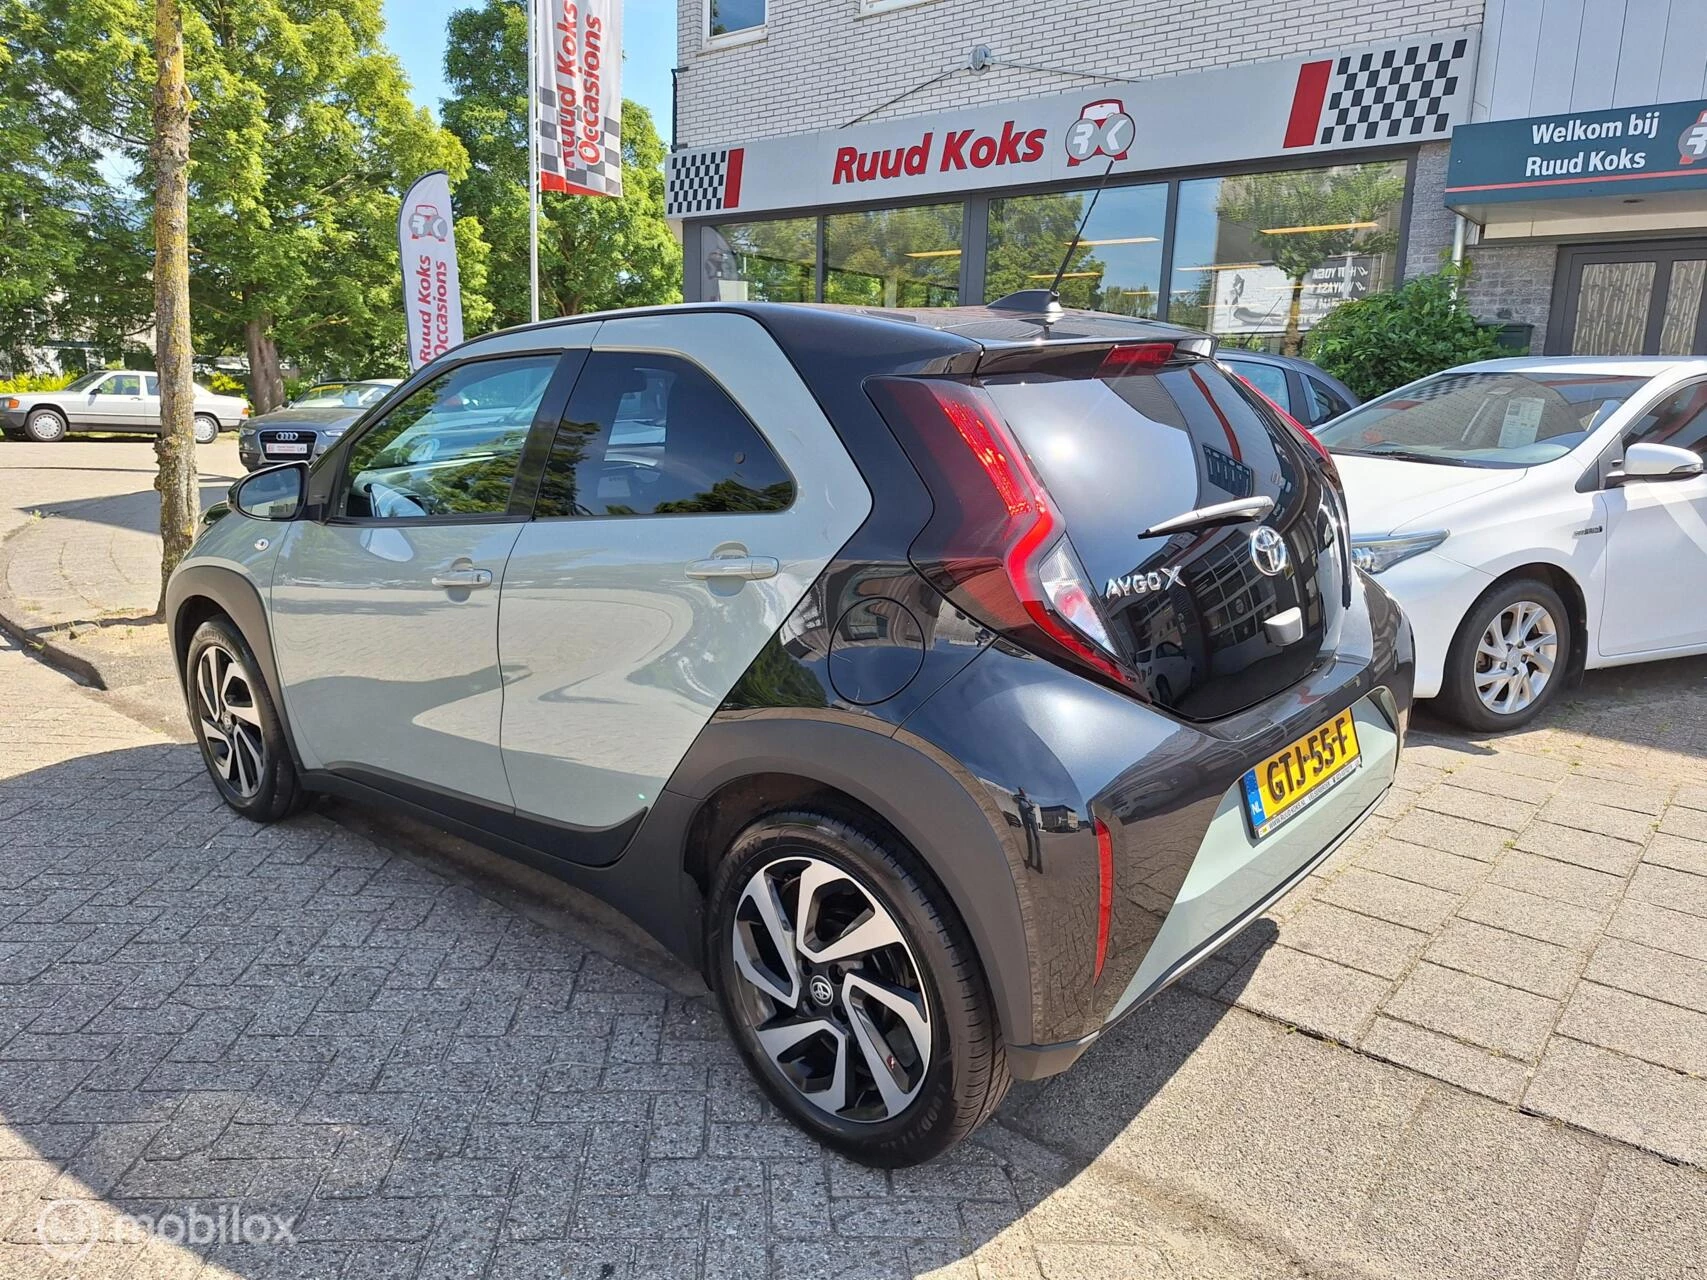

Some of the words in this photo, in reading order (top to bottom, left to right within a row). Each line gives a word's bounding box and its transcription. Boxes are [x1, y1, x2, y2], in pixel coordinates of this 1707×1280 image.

[556, 0, 578, 78] Koks
[577, 13, 602, 166] Occasions
[832, 132, 934, 185] Ruud
[939, 120, 1048, 172] Koks
[1531, 119, 1623, 145] Welkom
[1627, 111, 1660, 139] bij
[1525, 151, 1584, 177] Ruud
[1588, 147, 1646, 173] Koks
[416, 254, 432, 305] Koks
[418, 309, 432, 363] Ruud
[1267, 716, 1348, 803] GTJ-55-F
[1250, 800, 1263, 816] NL
